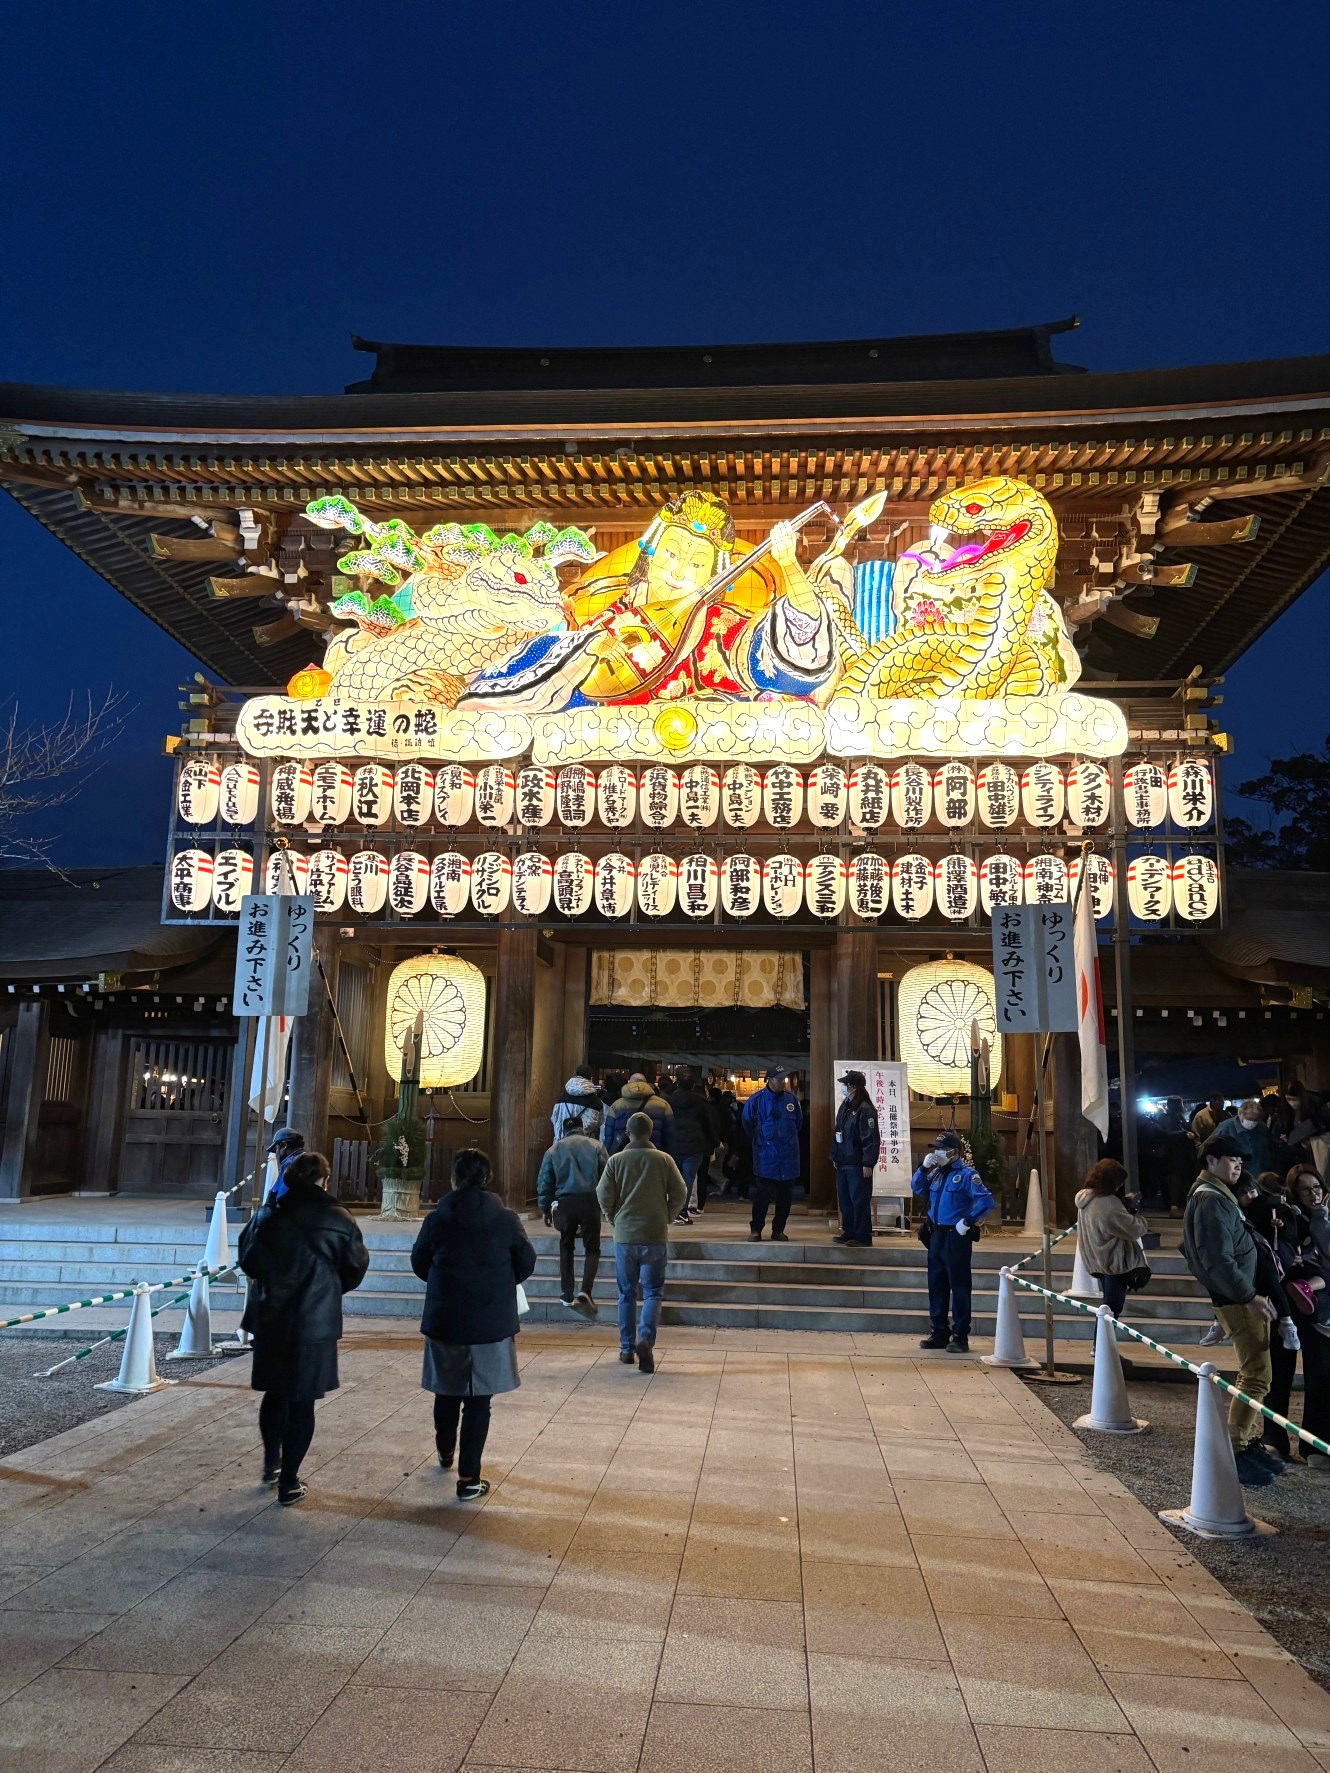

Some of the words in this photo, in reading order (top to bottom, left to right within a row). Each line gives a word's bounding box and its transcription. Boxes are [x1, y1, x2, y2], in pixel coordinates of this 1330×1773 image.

[193, 768, 208, 790] 山下
[316, 766, 337, 821] エモアホーム
[399, 767, 421, 822] 北岡本店
[436, 769, 450, 821] ディスプレイ
[685, 779, 703, 824] 中島一夫
[727, 780, 745, 824] 中島一夫
[771, 769, 793, 824] 竹中工務店
[860, 769, 883, 823] 丸井紙店
[904, 767, 924, 825] 長谷川製作所
[987, 780, 1007, 824] 田中雄二
[1134, 769, 1151, 825] 行政書士事務所
[1149, 766, 1162, 789] 小田
[1182, 765, 1206, 822] 森川栄介
[174, 854, 195, 907] 太平商事
[216, 856, 239, 906] エイブル
[322, 854, 336, 906] サイファーム
[351, 855, 364, 908] ごとう眼科
[446, 857, 461, 882] 湘南
[475, 856, 491, 910] リサイクル
[486, 854, 501, 897] フジシロ
[515, 856, 530, 911] ガーデンテラス
[641, 872, 651, 911] クリニック
[729, 857, 752, 912] 阿部和彦
[769, 860, 784, 915] コーポレーション
[900, 861, 917, 914] 建材土木
[988, 862, 1009, 906] 田中敏
[1186, 858, 1208, 917] advance
[242, 902, 269, 1007] お進み下さい
[287, 904, 307, 972] ゆっくり
[1042, 912, 1066, 984] ゆっくり
[1000, 912, 1027, 1022] お進み下さい
